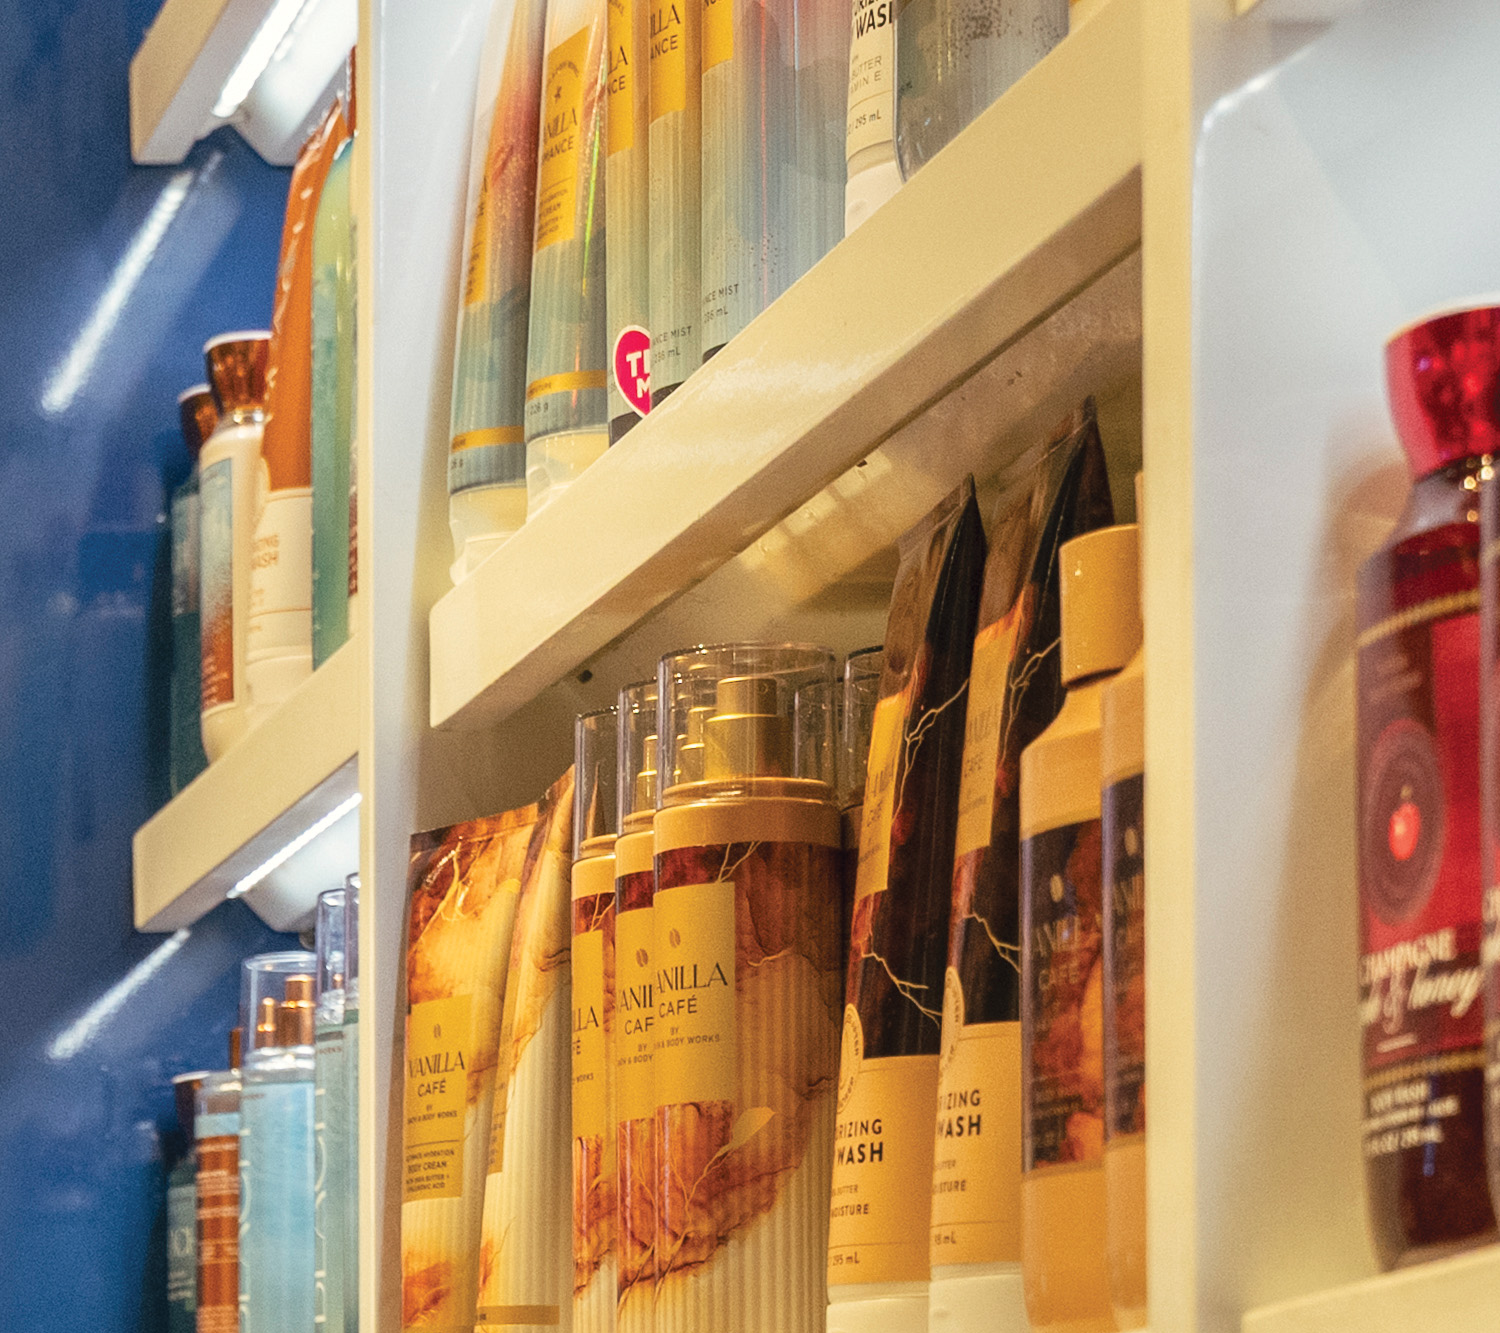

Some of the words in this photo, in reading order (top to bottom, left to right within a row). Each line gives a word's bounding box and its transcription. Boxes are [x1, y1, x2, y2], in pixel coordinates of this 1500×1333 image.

[650, 4, 681, 40] ILLA
[650, 34, 679, 60] ANCE
[657, 961, 729, 995] ANILLA
[659, 994, 699, 1019] CAFÉ
[625, 1016, 655, 1036] CAF
[687, 1034, 721, 1045] WORKS
[408, 1050, 466, 1079] VANILLA
[633, 1053, 654, 1064] BODY
[417, 1078, 446, 1098] CAFÉ
[437, 1110, 458, 1120] WORKS
[836, 1118, 884, 1139] RIZING
[837, 1140, 884, 1167] WASH
[423, 1160, 447, 1171] CREAM
